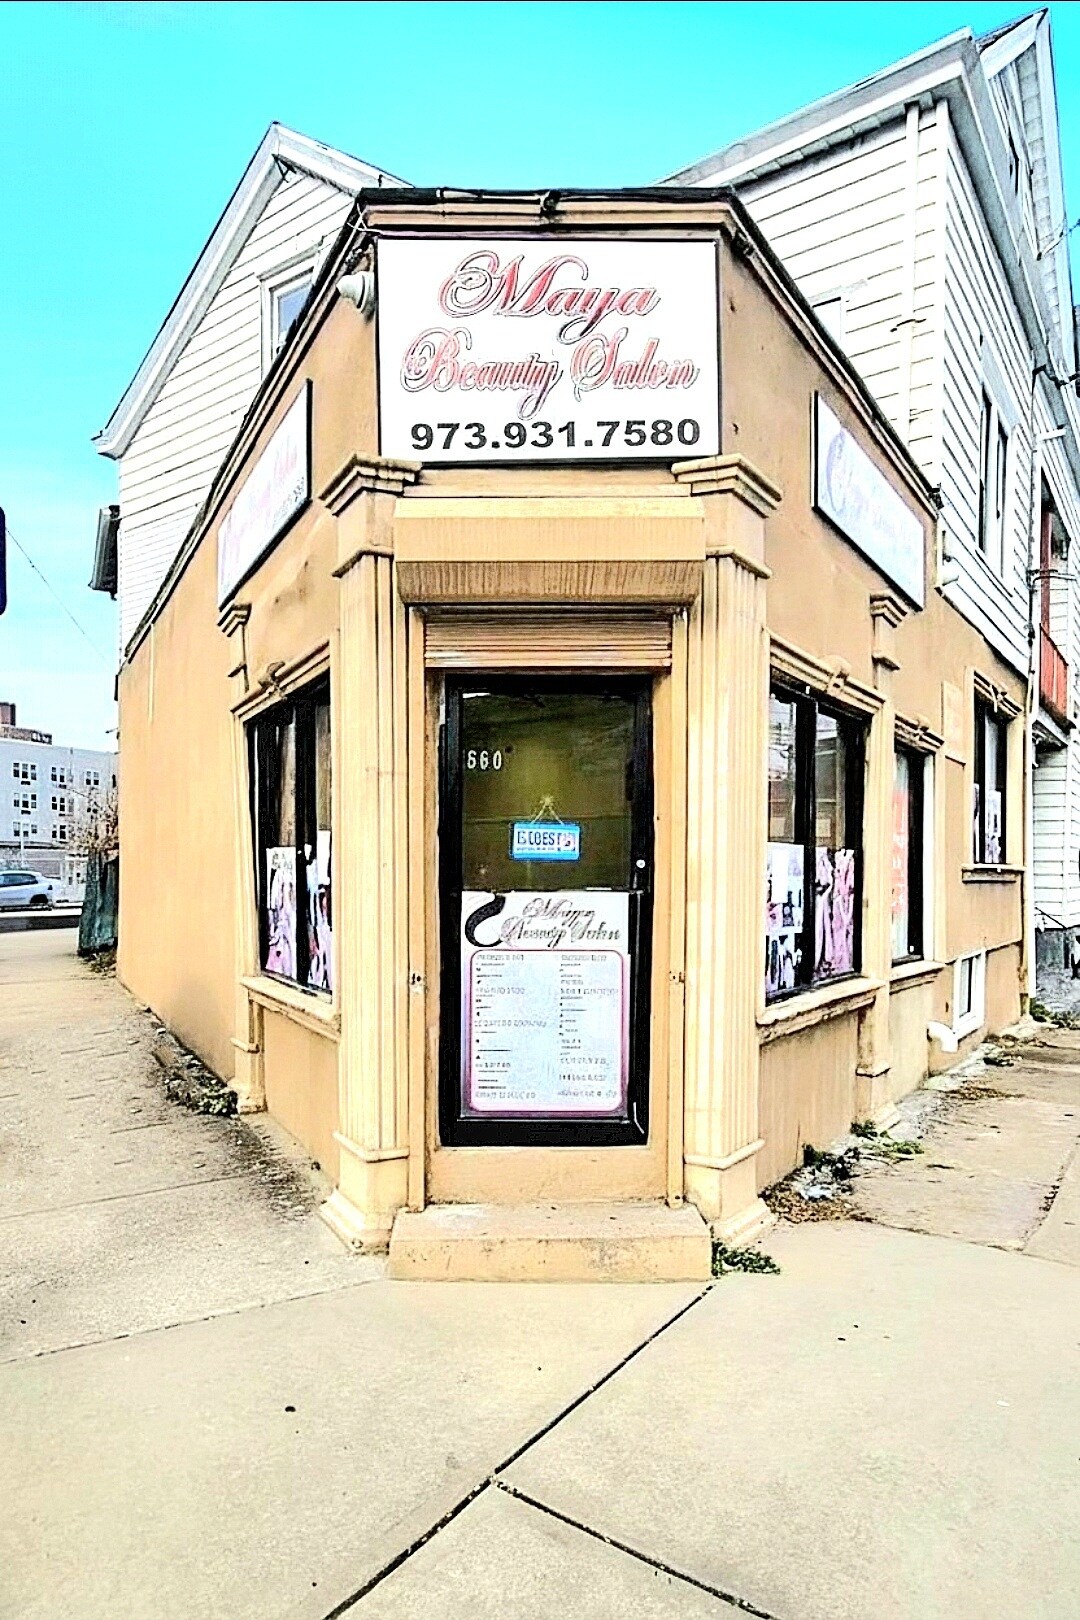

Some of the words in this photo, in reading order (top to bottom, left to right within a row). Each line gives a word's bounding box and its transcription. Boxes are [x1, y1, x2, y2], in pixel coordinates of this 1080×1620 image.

[438, 250, 661, 345] Maya
[400, 327, 564, 421] Beauty
[570, 327, 700, 402] Salon
[411, 419, 700, 450] 973.931.7580
[467, 750, 502, 770] 660
